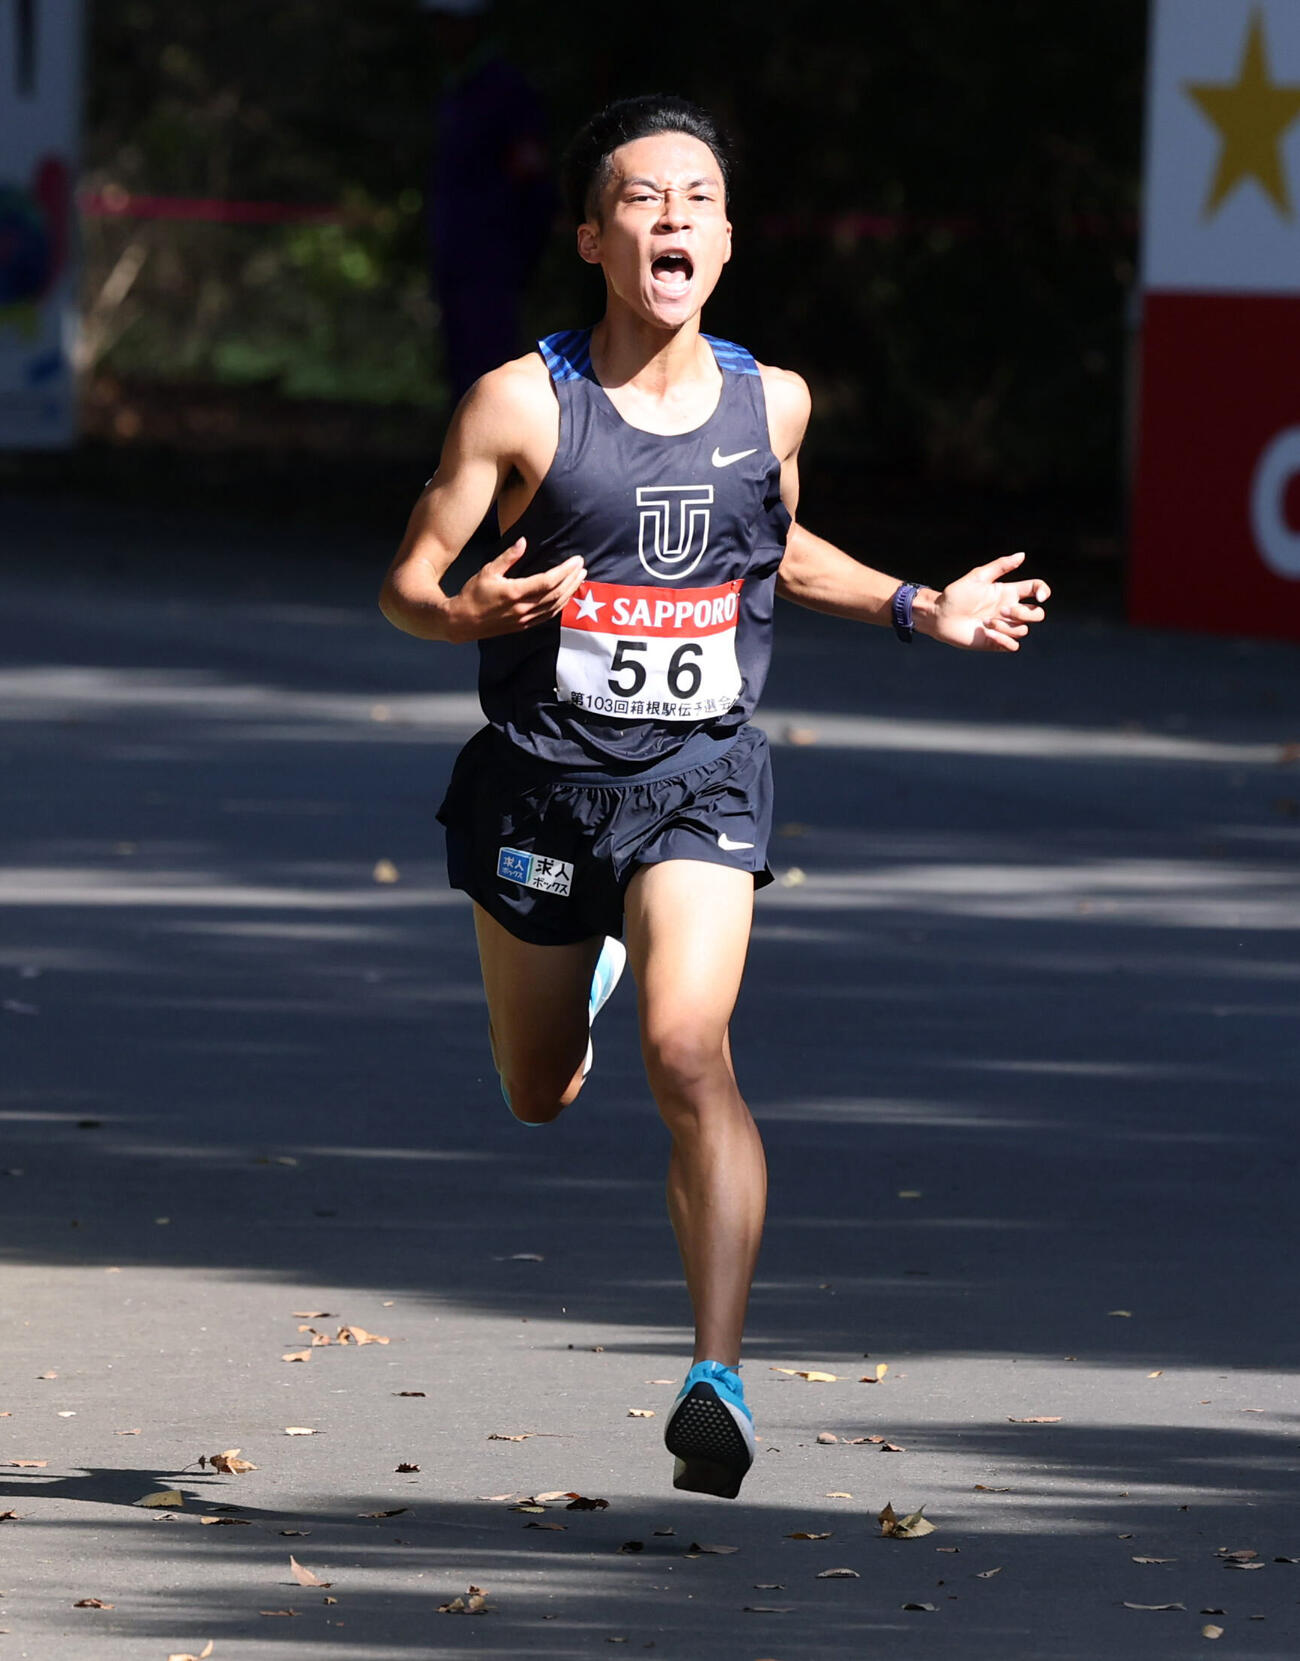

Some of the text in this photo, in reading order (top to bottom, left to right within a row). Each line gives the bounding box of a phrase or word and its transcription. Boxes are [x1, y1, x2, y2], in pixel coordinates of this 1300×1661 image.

[611, 592, 737, 628] SAPPORO
[536, 858, 570, 881] 求人
[533, 878, 568, 895] ボックス
